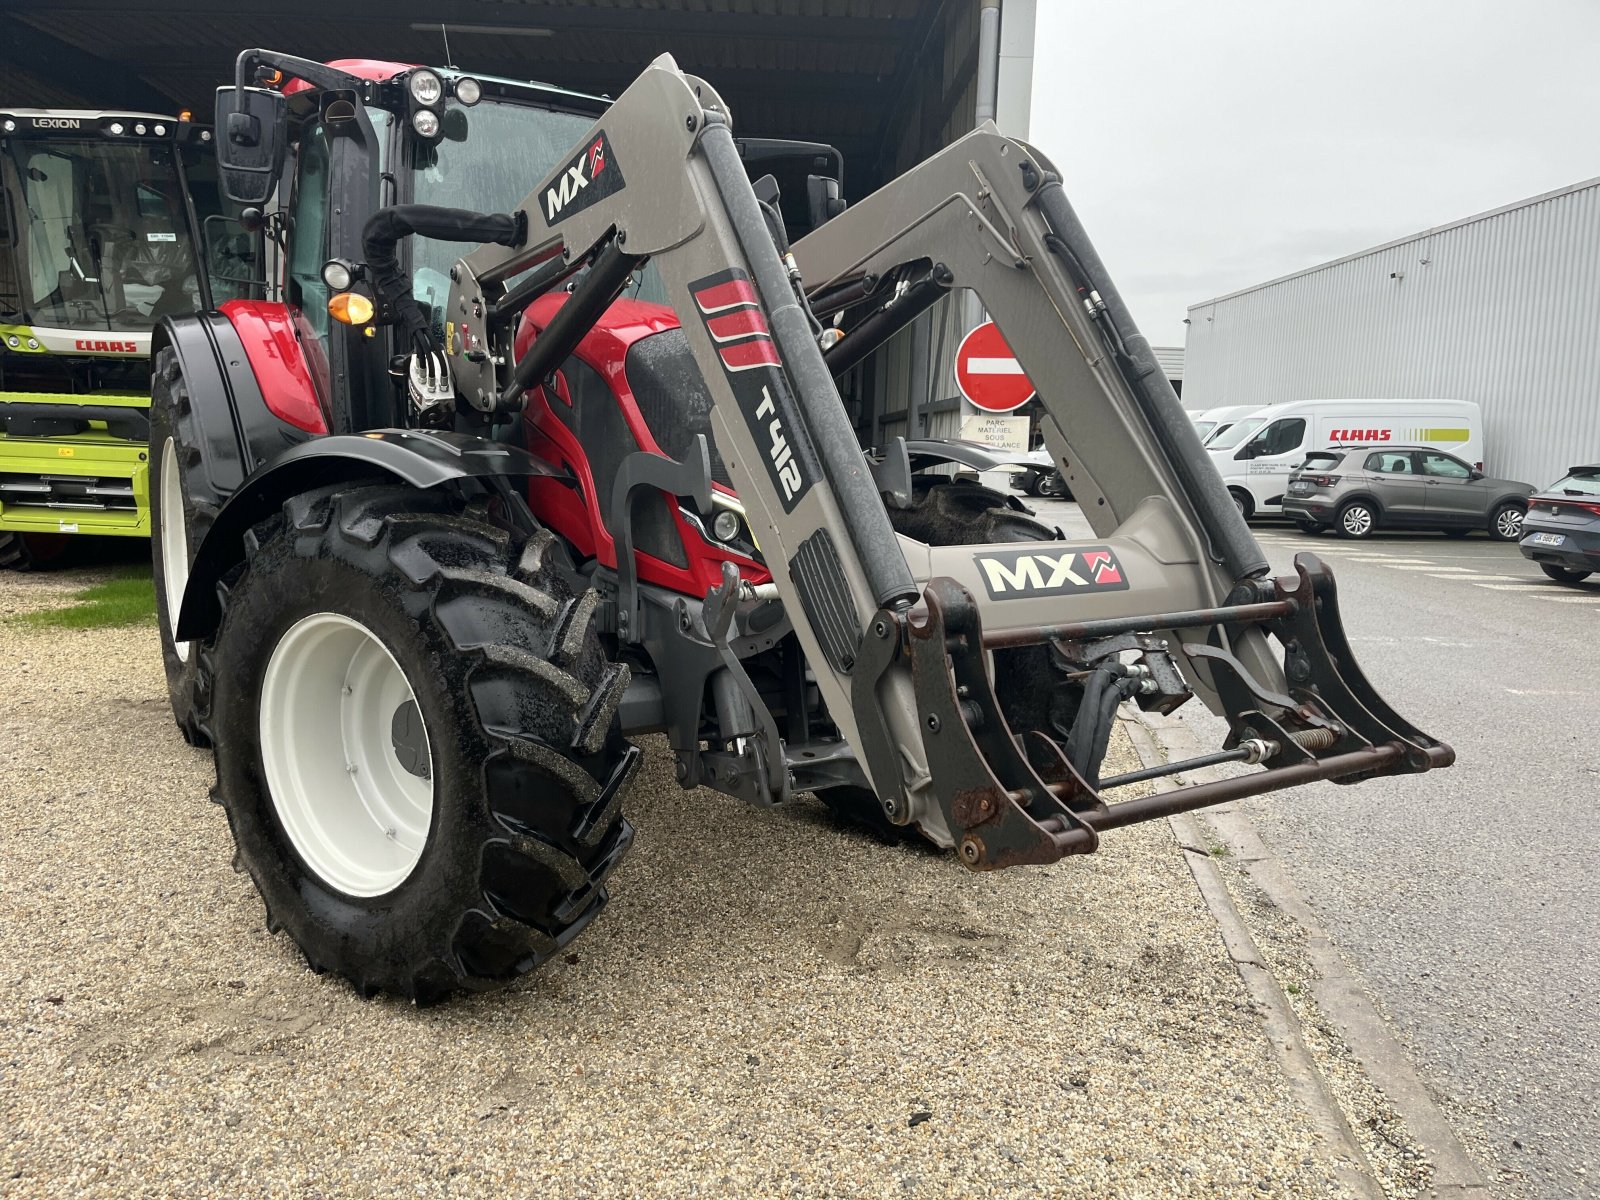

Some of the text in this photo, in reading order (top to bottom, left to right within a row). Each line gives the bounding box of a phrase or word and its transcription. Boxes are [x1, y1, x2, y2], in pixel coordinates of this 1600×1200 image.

[32, 118, 80, 129] LEXION
[547, 152, 589, 221] MX
[75, 340, 137, 353] CLAAS
[1329, 429, 1392, 442] CLAAS
[979, 553, 1090, 592] MX
